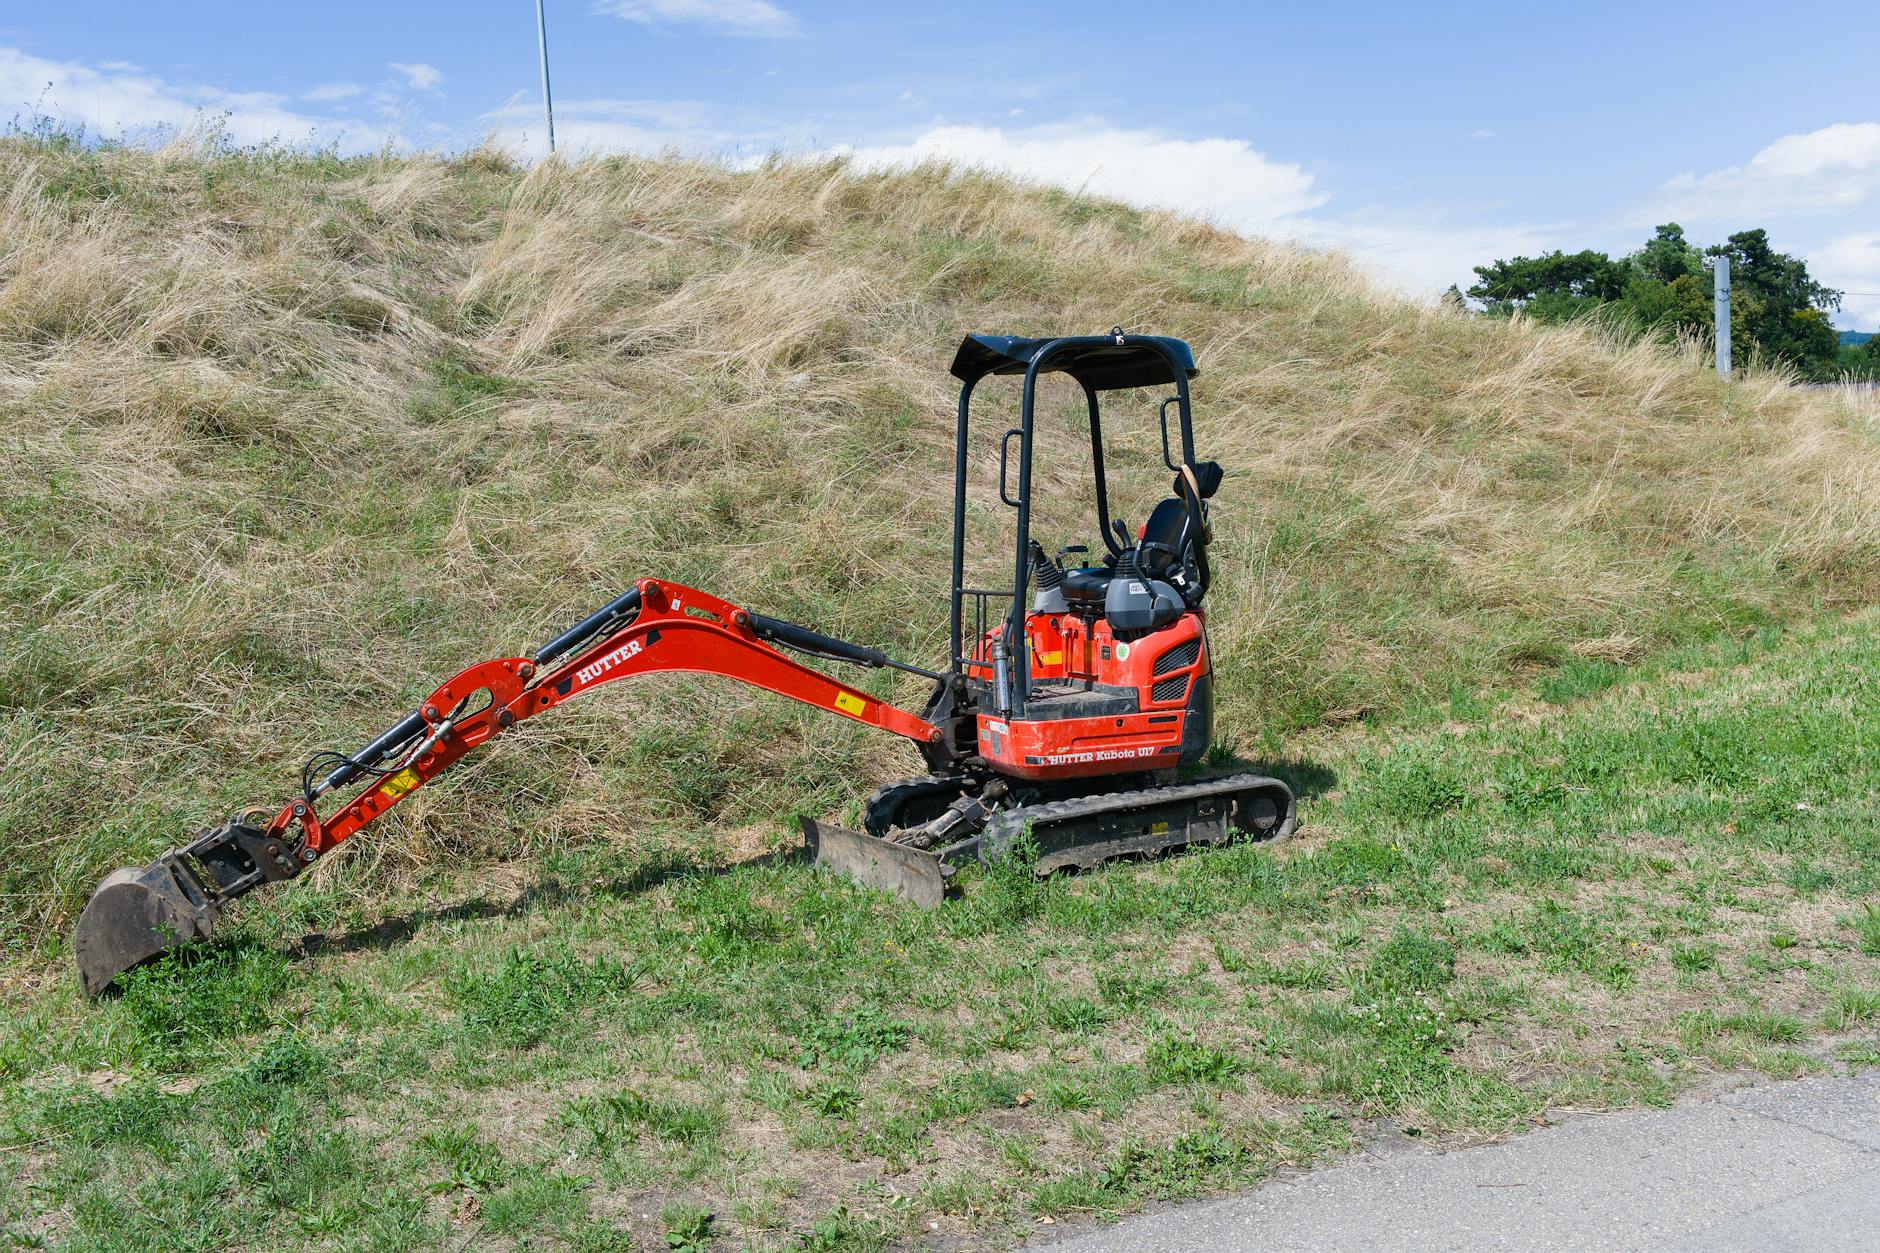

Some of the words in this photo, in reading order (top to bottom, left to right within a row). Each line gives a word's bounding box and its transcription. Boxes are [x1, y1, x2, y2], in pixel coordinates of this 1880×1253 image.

[576, 640, 642, 684] HUTTER
[1050, 752, 1093, 765] HUTTER
[1096, 749, 1135, 760] Kubota
[1138, 746, 1154, 757] U17
